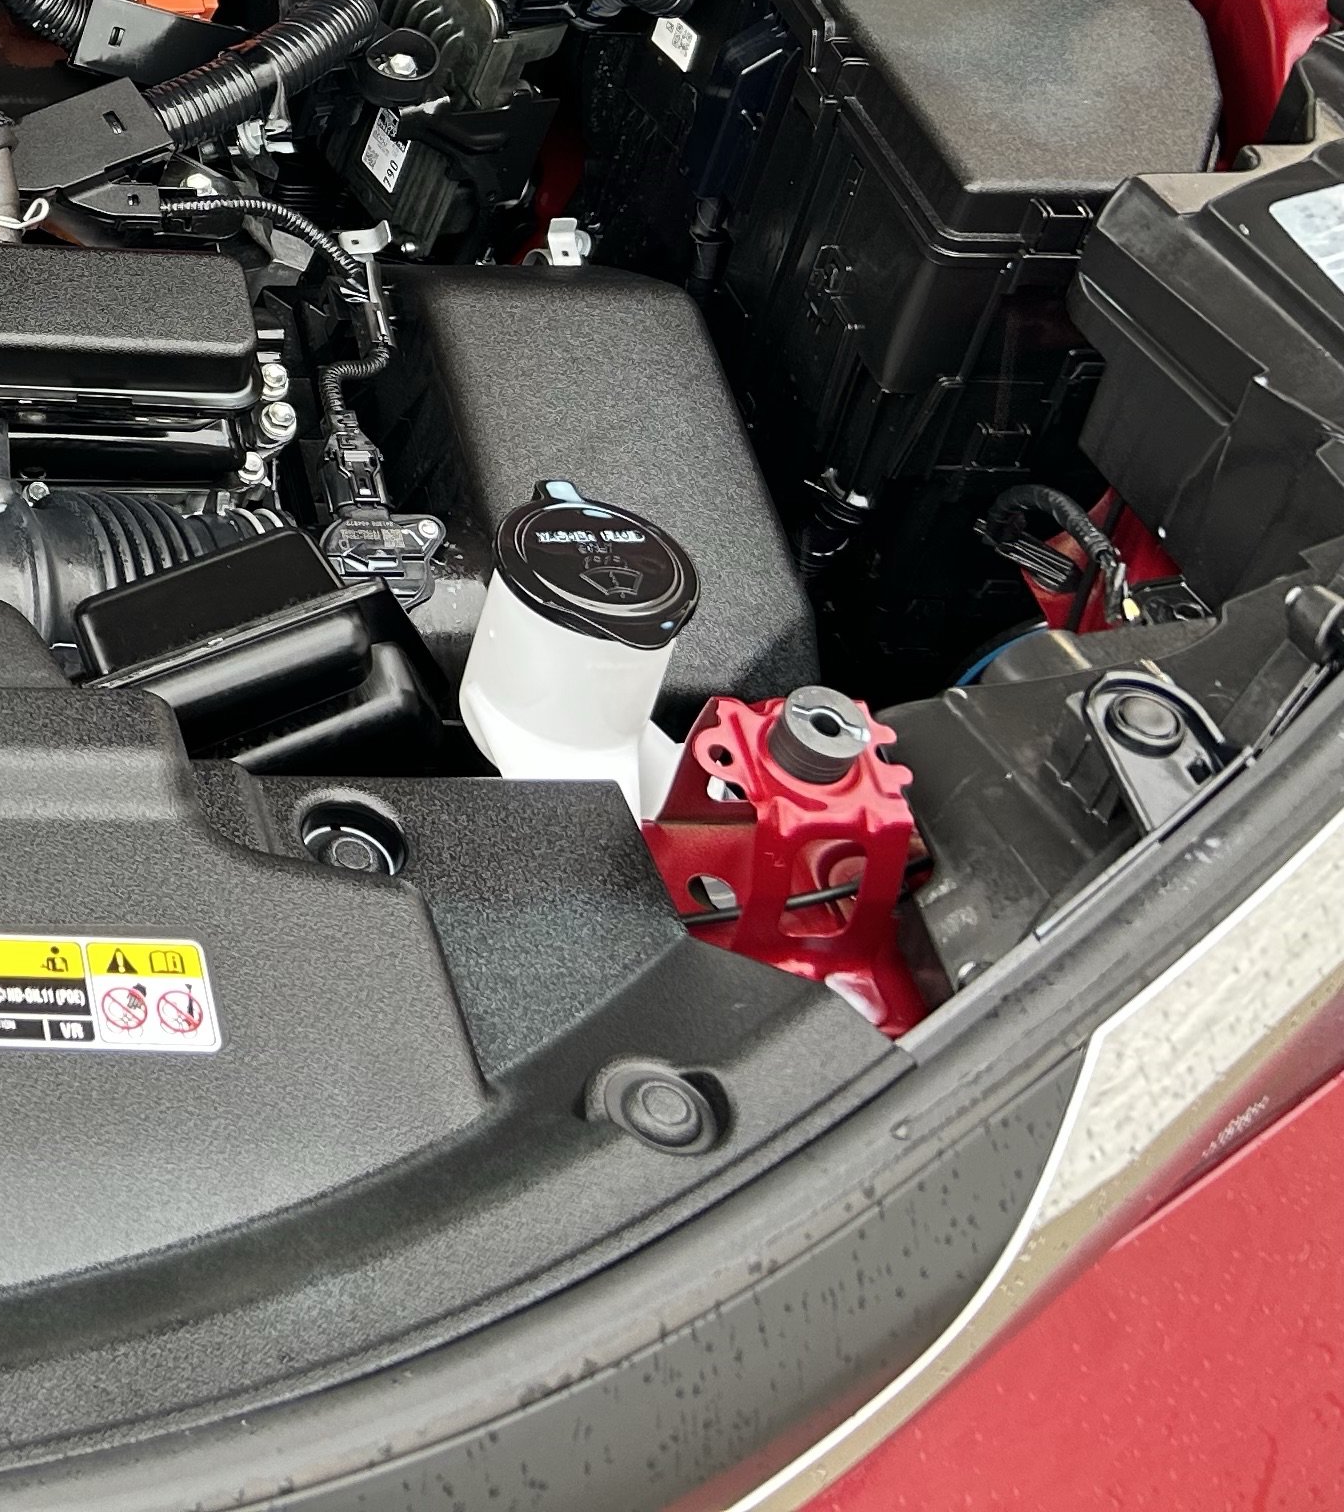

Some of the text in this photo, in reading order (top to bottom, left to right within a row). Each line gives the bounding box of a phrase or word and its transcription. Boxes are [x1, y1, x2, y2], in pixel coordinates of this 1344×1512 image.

[382, 159, 399, 189] 790
[535, 529, 645, 543] WASHER FLUID
[59, 1021, 85, 1039] VR
